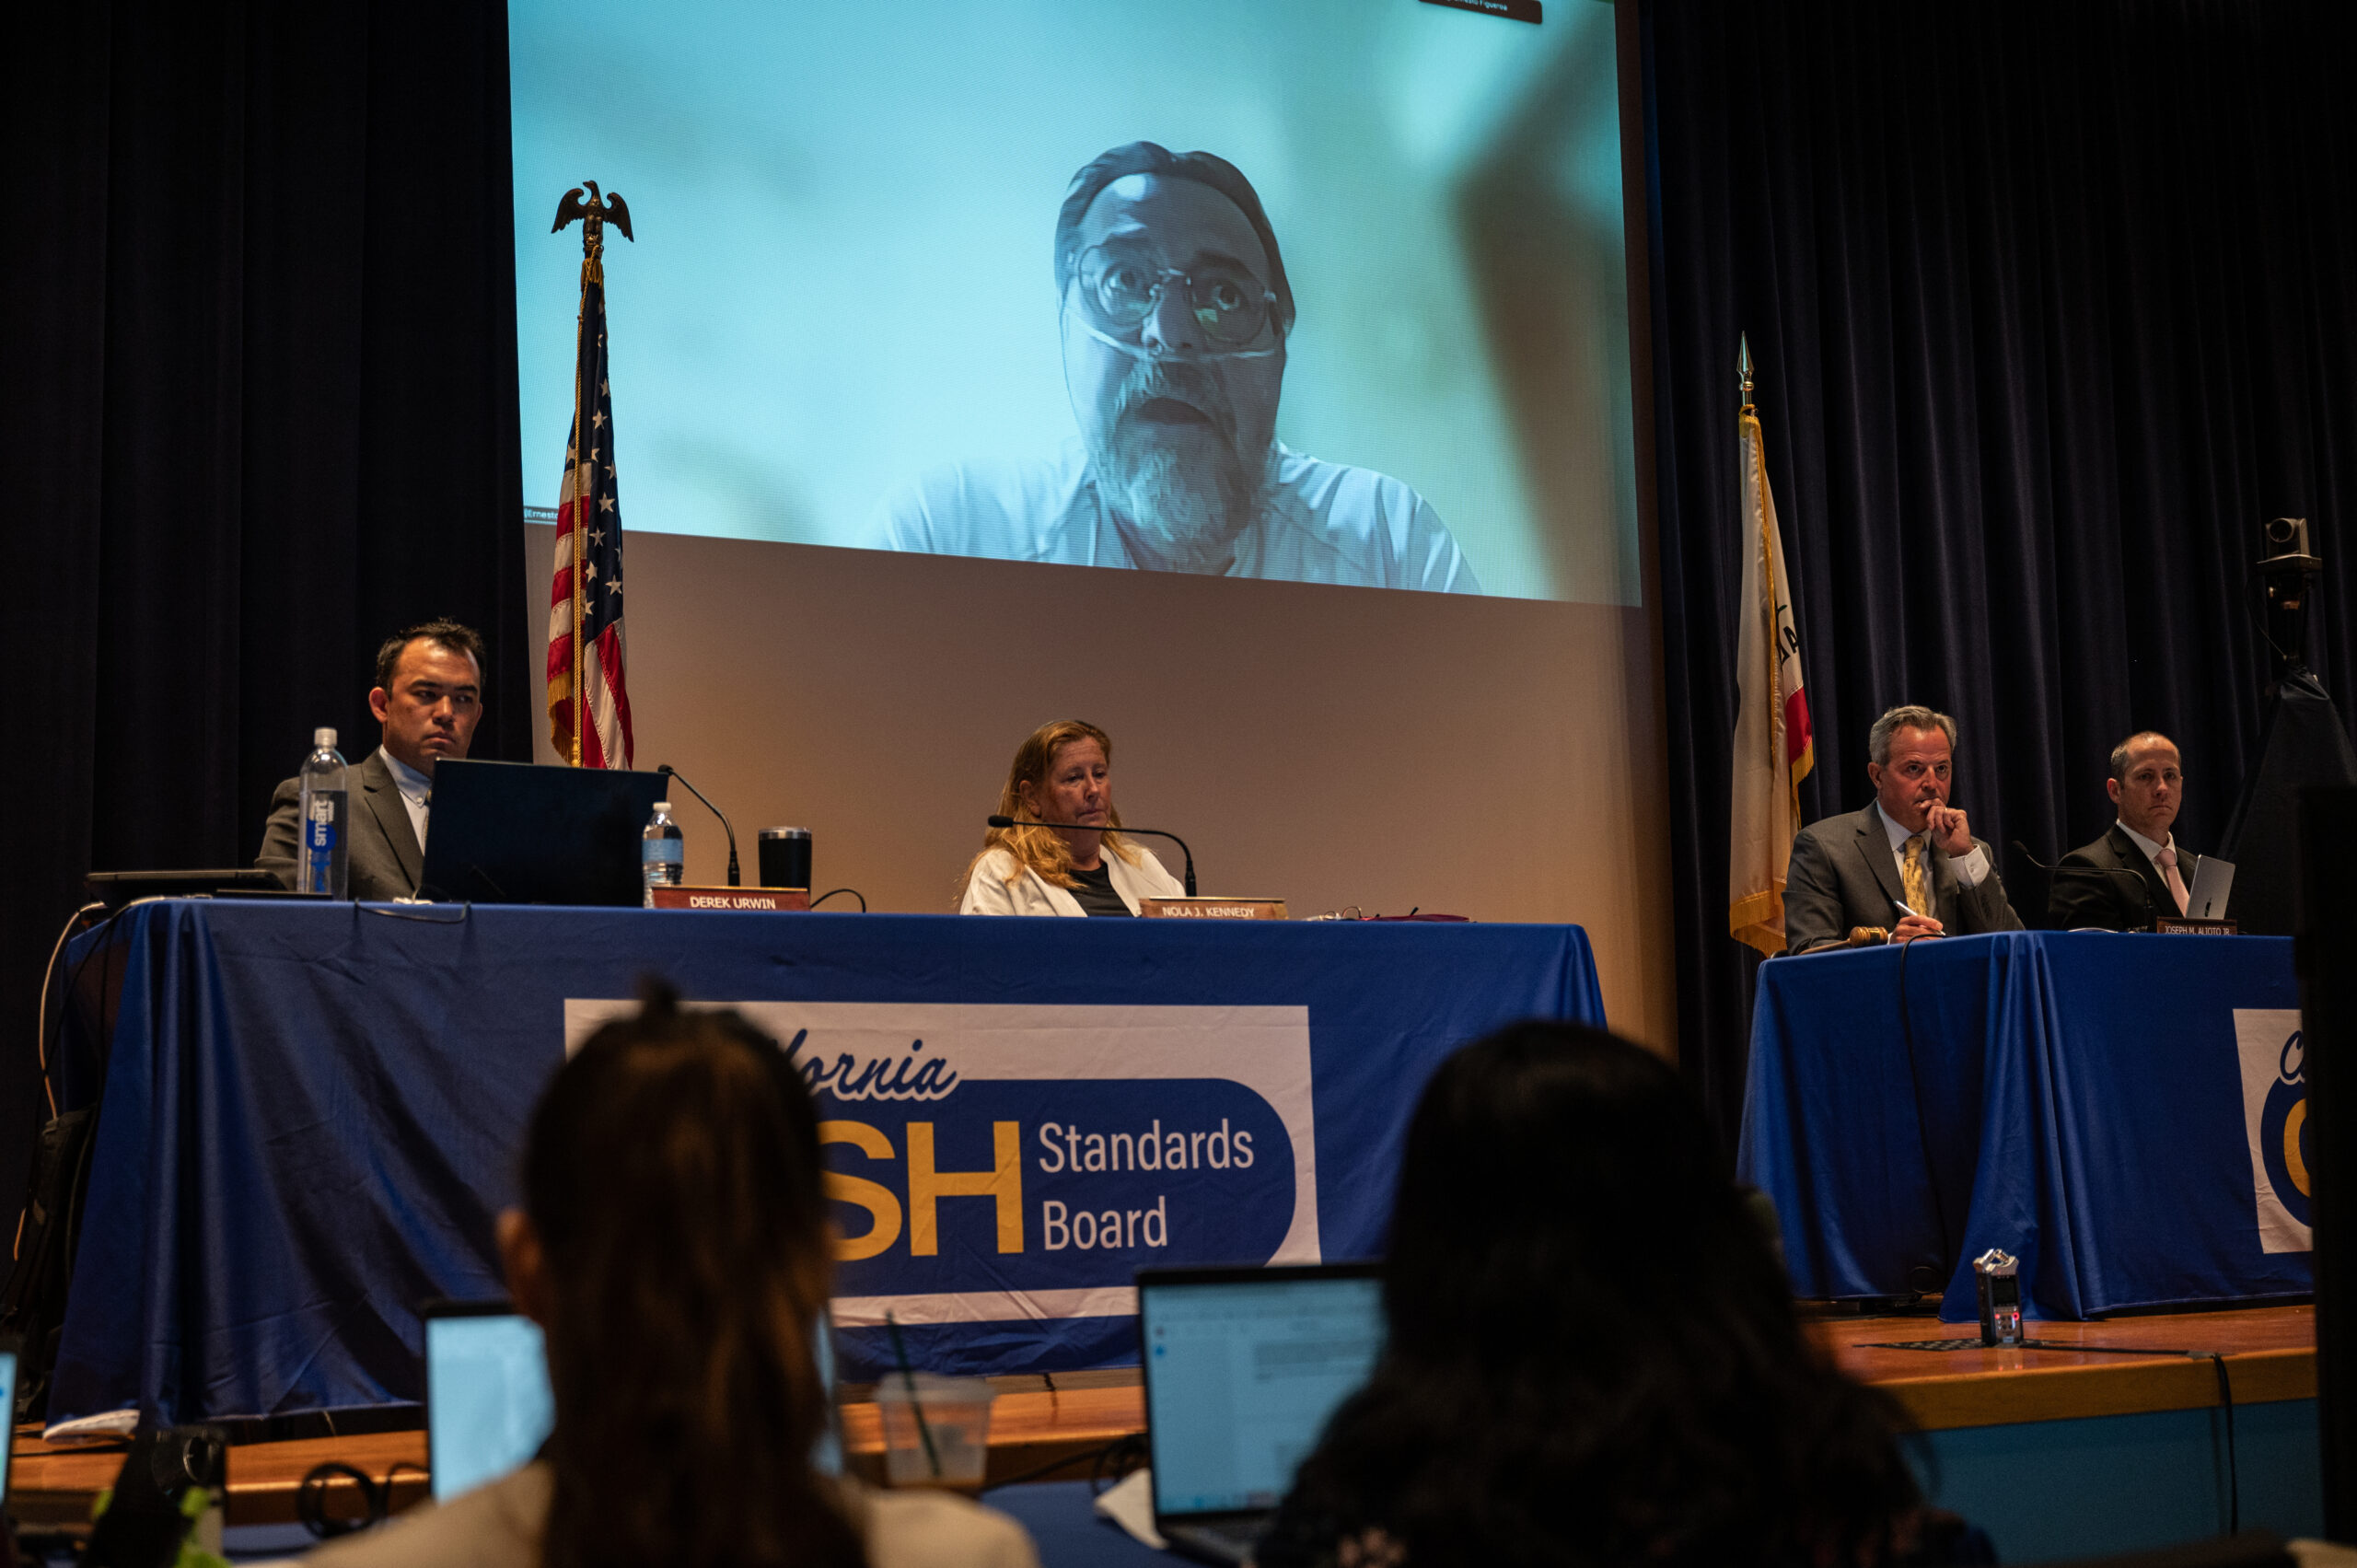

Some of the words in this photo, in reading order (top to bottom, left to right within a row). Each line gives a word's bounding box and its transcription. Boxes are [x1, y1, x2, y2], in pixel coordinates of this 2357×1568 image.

[314, 799, 327, 847] smart
[690, 896, 731, 908] DEREK
[733, 897, 776, 910] URWIN
[1162, 906, 1193, 917] NOLA
[1194, 907, 1204, 917] J.
[1205, 907, 1255, 917] KENNEDY
[2165, 925, 2188, 935] JOSEPH
[2189, 926, 2197, 935] M.
[2198, 926, 2222, 935] ALIOTO
[784, 1028, 958, 1096] ornia
[1038, 1118, 1255, 1173] Standards
[816, 1119, 1025, 1261] SH
[1042, 1195, 1168, 1250] Board
